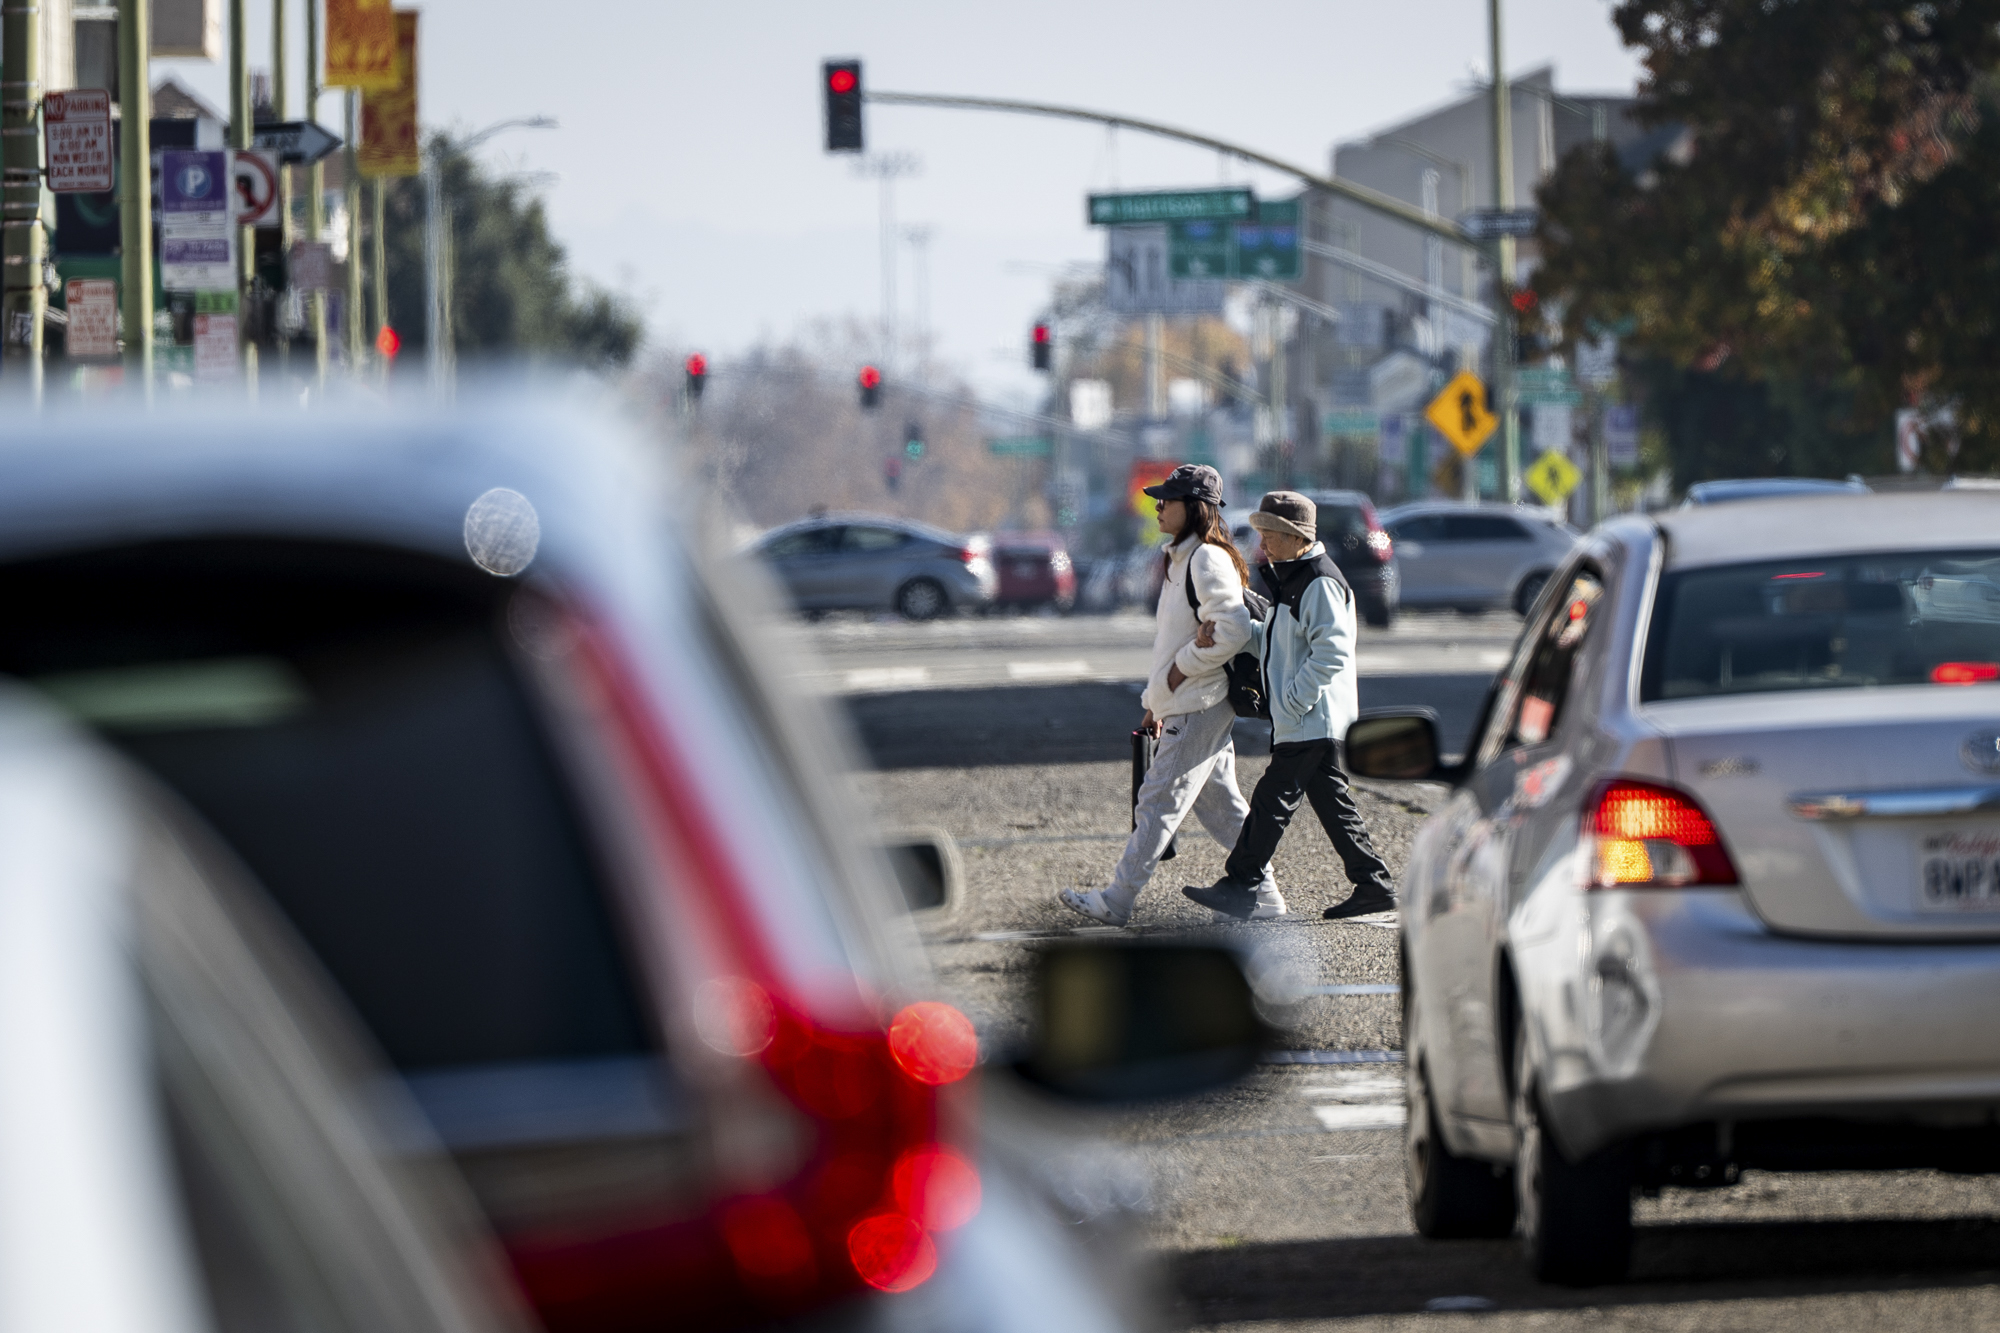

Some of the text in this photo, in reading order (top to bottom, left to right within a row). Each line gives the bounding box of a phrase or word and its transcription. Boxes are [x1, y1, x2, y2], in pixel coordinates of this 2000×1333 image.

[46, 95, 107, 119] NO PARKING
[93, 125, 104, 137] TO
[85, 139, 97, 150] AM
[53, 153, 71, 164] MON
[51, 164, 109, 178] EACH MONTH
[187, 169, 205, 195] P
